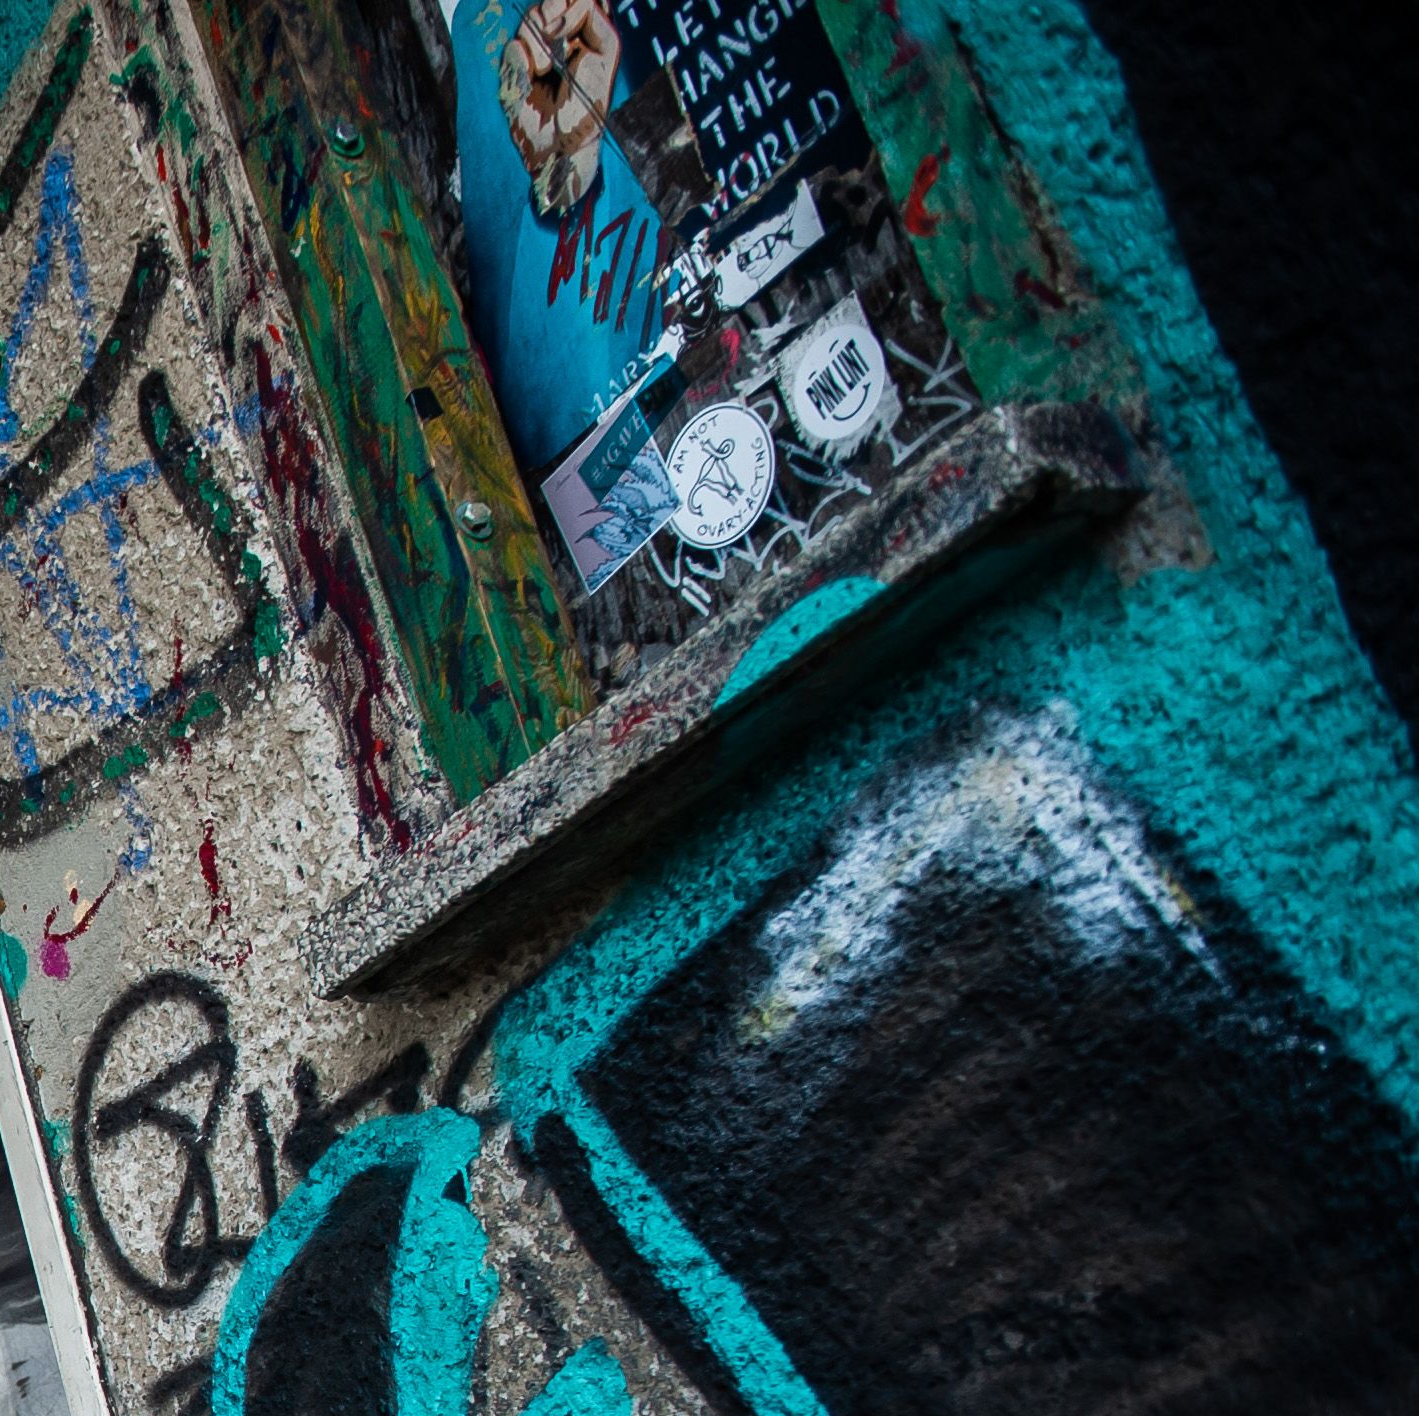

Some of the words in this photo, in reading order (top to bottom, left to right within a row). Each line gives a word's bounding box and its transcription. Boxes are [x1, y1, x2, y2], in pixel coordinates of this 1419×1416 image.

[700, 55, 793, 149] THE
[805, 366, 848, 420] PINK
[831, 338, 870, 391] LINT
[689, 413, 720, 444] NOT
[697, 436, 766, 538] OVARY-ACTING
